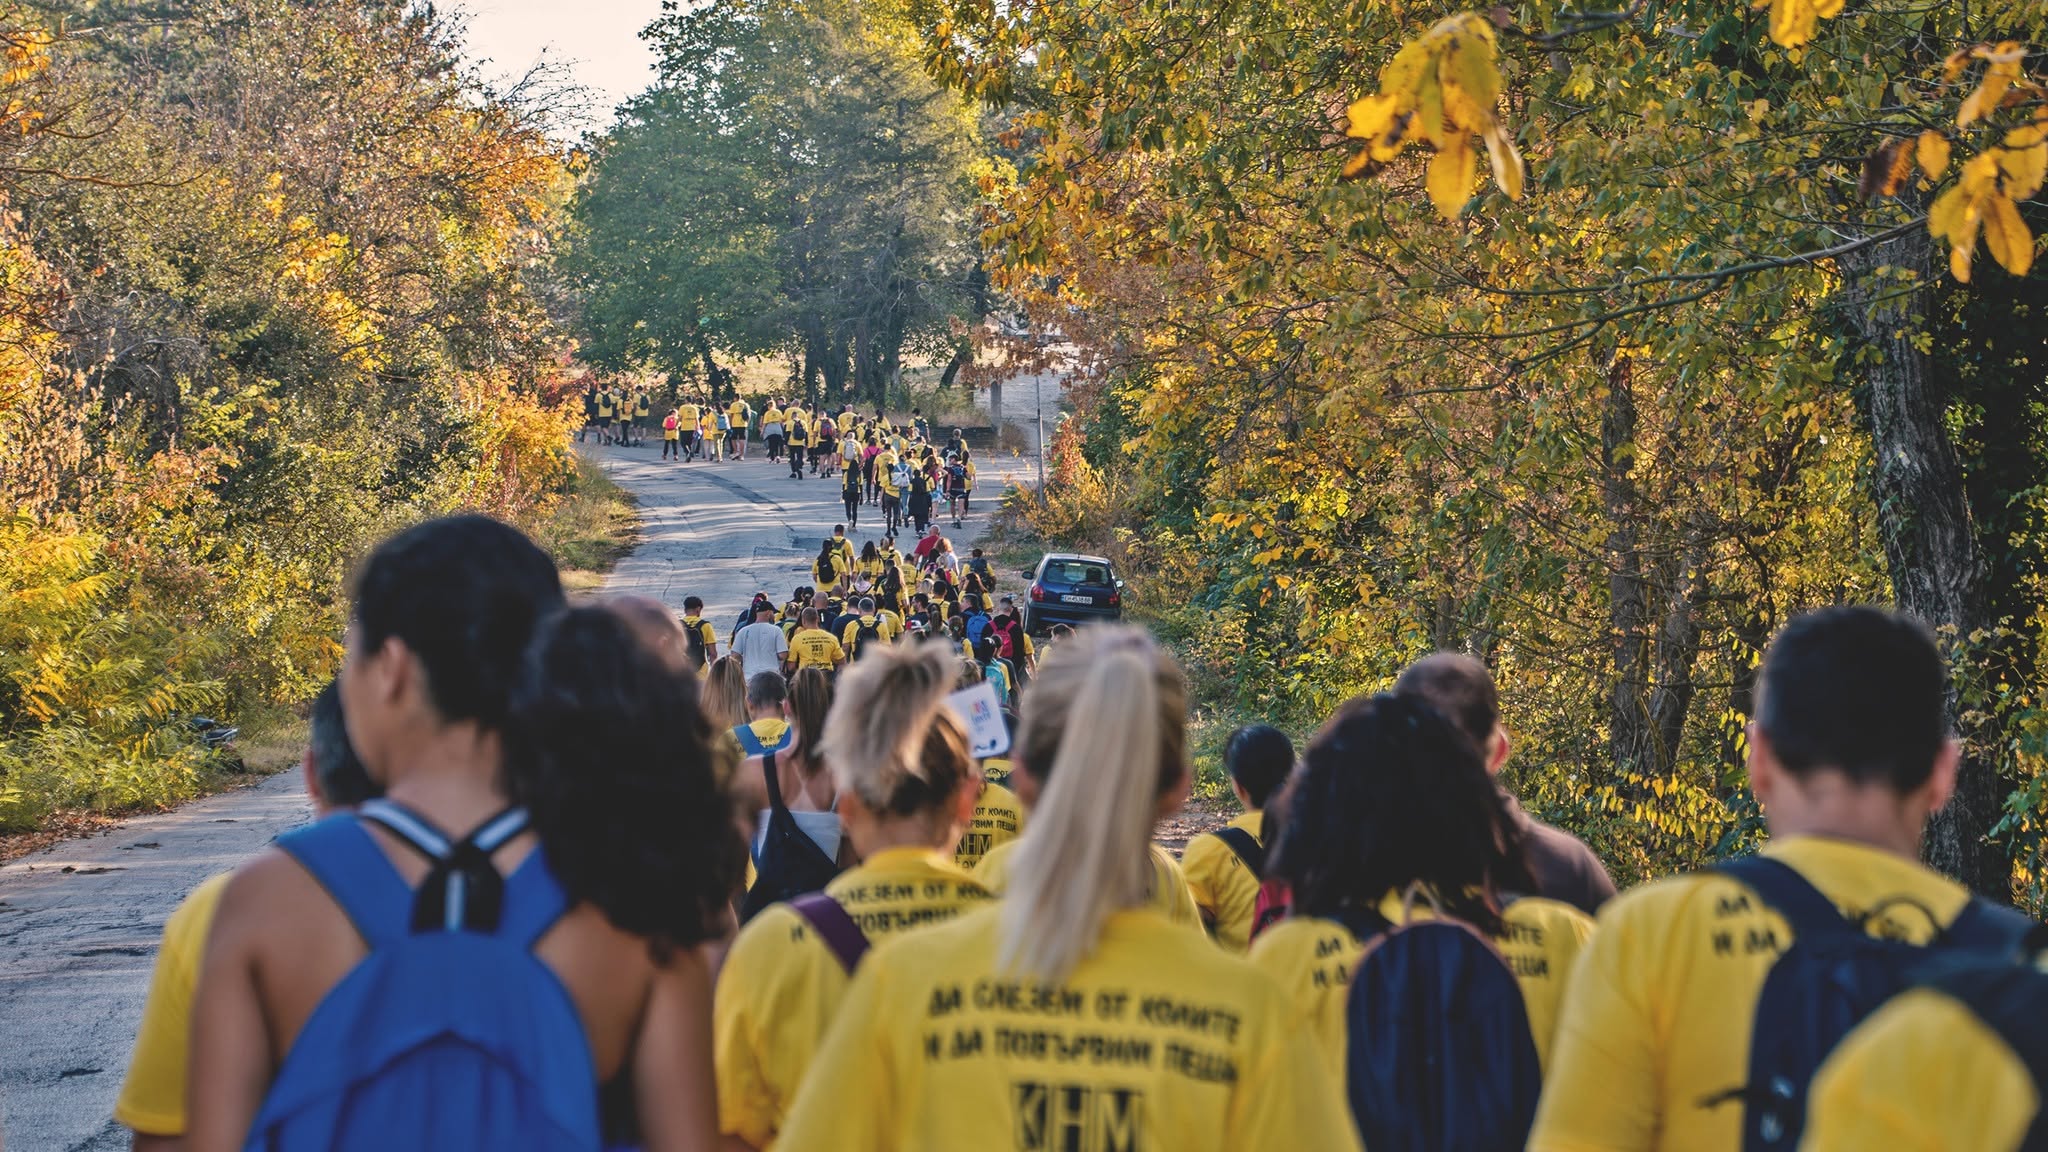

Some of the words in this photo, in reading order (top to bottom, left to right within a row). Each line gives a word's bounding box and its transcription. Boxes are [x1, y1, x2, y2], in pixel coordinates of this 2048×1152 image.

[975, 806, 985, 816] ОТ
[988, 807, 1017, 821] КОЛИТЕ
[1315, 936, 1342, 958] ДА
[1312, 966, 1330, 988] И
[1334, 962, 1349, 986] Д
[929, 984, 962, 1018] ДА
[973, 979, 1085, 1019] СЛЕЗЕМ
[1095, 986, 1128, 1021] ОТ
[1138, 994, 1240, 1045] КОЛИТЕ
[923, 1030, 941, 1061] И
[951, 1027, 983, 1059] ДА
[994, 1025, 1153, 1072] ПОВЪРВИМ
